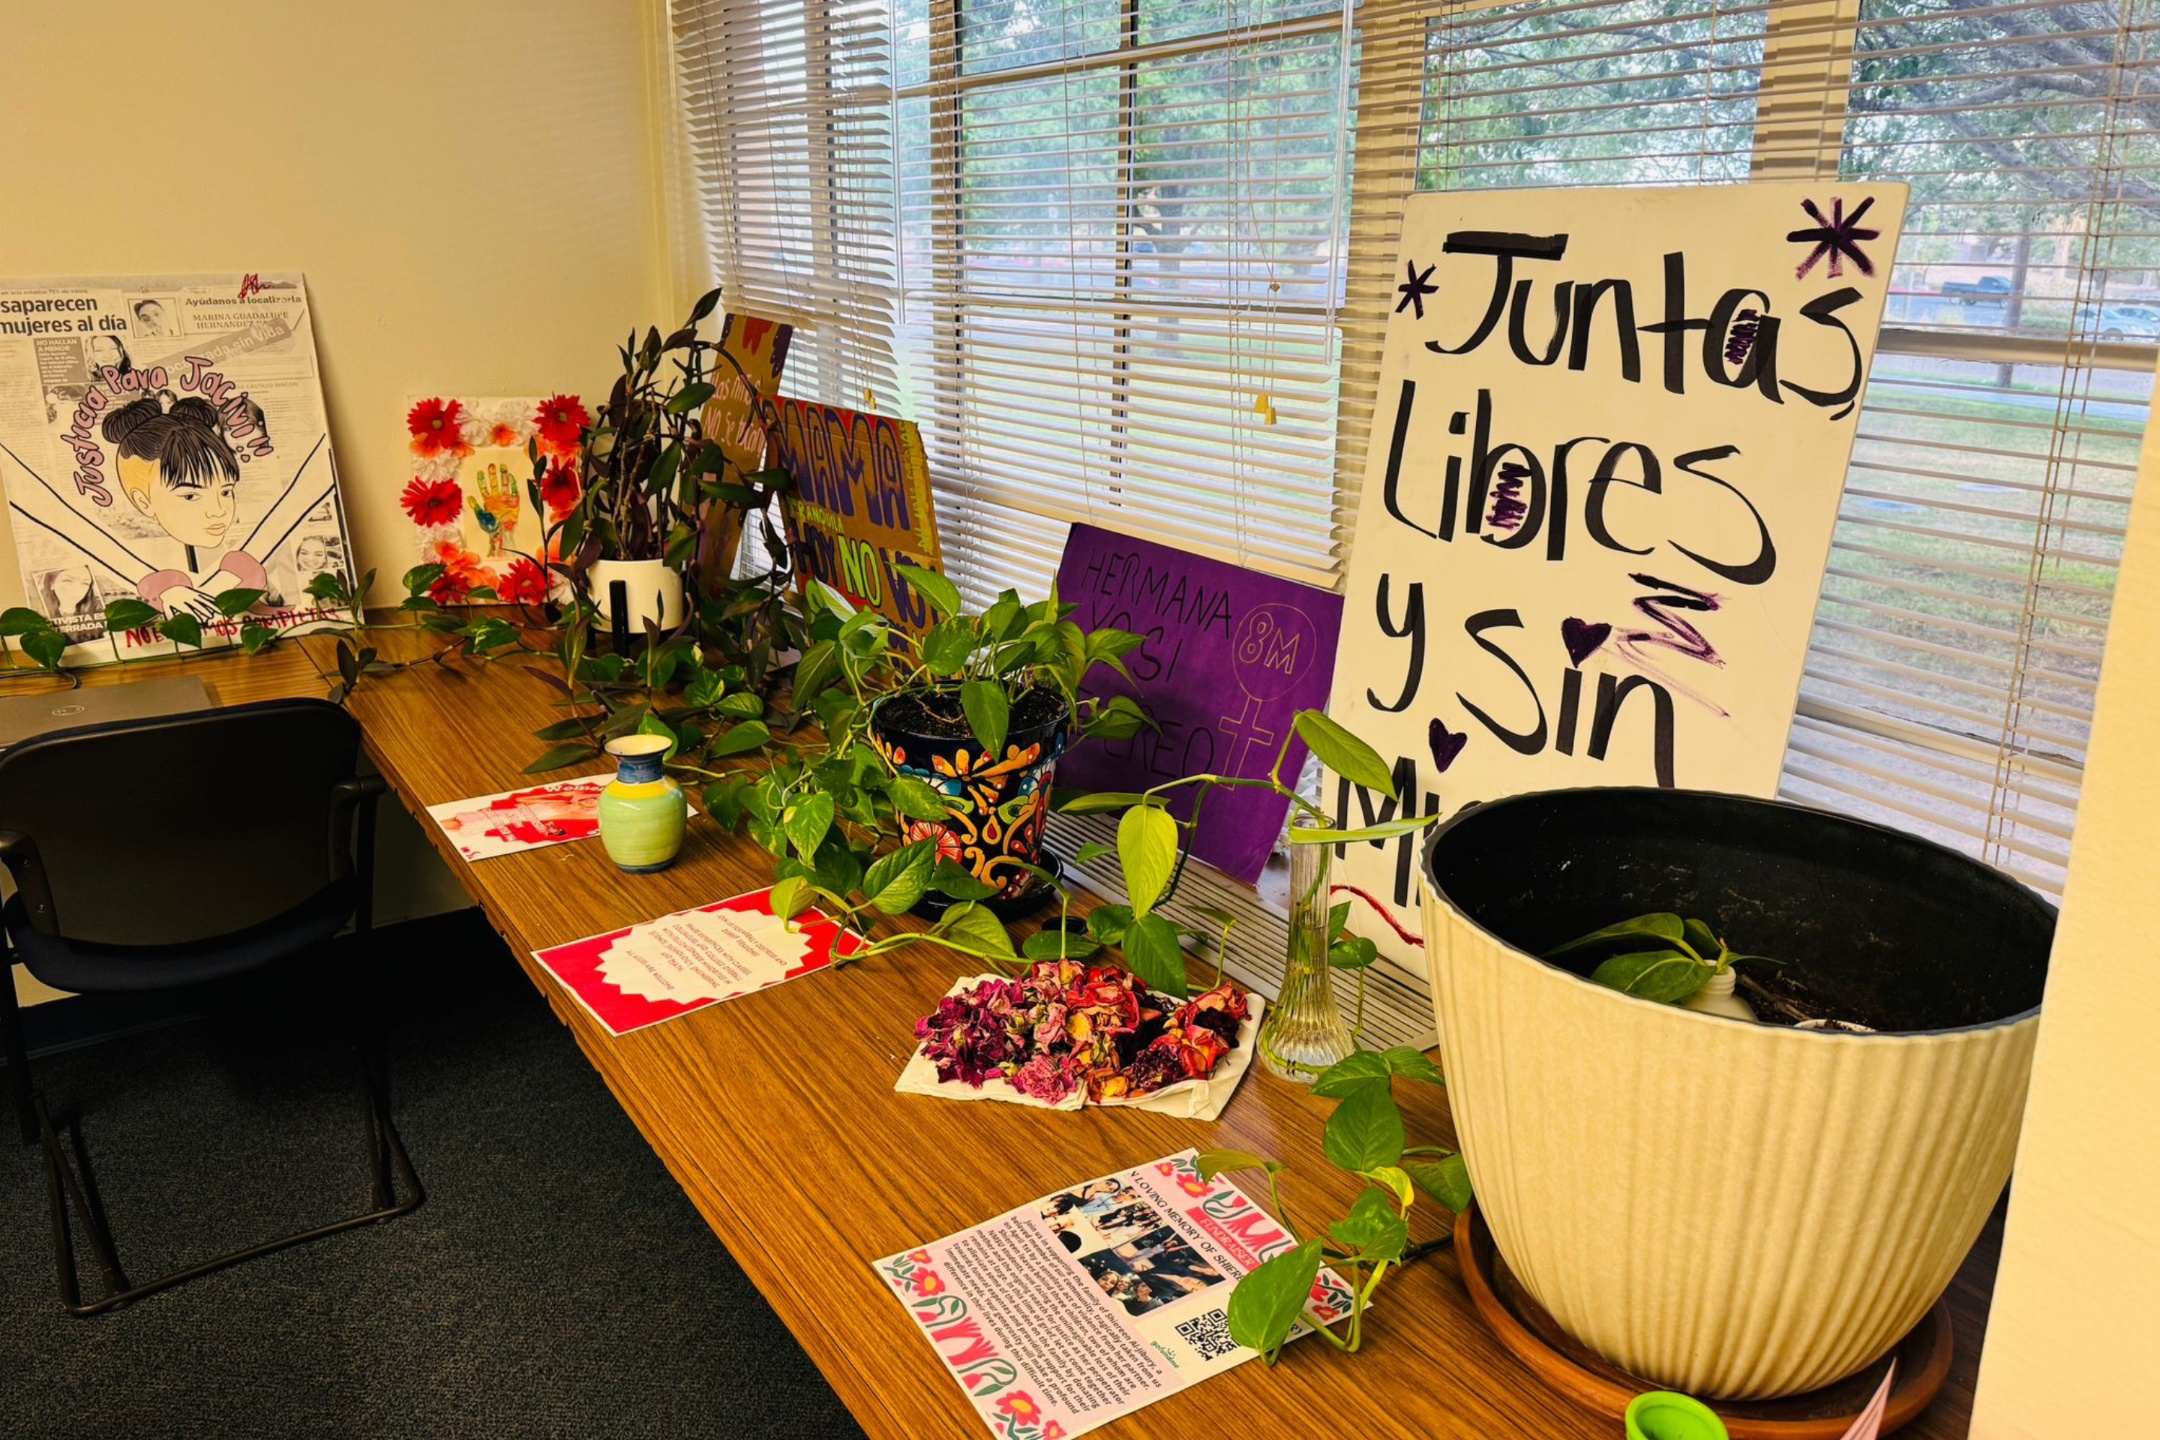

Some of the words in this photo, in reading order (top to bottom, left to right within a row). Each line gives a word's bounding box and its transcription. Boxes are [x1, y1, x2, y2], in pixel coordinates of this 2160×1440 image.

[0, 317, 73, 336] mujeres
[78, 315, 94, 332] al
[99, 314, 127, 331] día
[1, 298, 98, 316] saparecen
[193, 313, 231, 322] MARINA
[232, 336, 255, 351] sin
[247, 295, 301, 305] localizarla
[101, 364, 169, 394] Para
[1383, 379, 1777, 586] Libres
[837, 533, 882, 609] NO
[1081, 547, 1232, 641] HERMANA
[1132, 625, 1184, 683] SI
[1238, 611, 1301, 675] 8M
[1132, 1176, 1170, 1208] LOVING
[1163, 1207, 1204, 1241] MEMORY
[1198, 1240, 1217, 1254] OF
[1197, 1217, 1256, 1266] FUNDRAISER
[943, 1261, 968, 1291] difference
[970, 1297, 985, 1311] their
[982, 1310, 997, 1327] lives
[994, 1326, 1013, 1349] during
[1010, 1348, 1023, 1362] this
[1020, 1361, 1045, 1388] difficult
[944, 1247, 971, 1279] immediate
[984, 1297, 998, 1311] Your
[992, 1311, 1024, 1346] generosity
[1021, 1345, 1035, 1359] will
[1030, 1358, 1049, 1377] make
[1048, 1382, 1080, 1414] profound
[952, 1242, 973, 1267] towards
[970, 1266, 992, 1288] funeral
[987, 1287, 1012, 1315] expenses
[1008, 1314, 1023, 1327] and
[1016, 1326, 1046, 1359] providing
[1042, 1357, 1067, 1384] support
[1064, 1383, 1076, 1394] for
[1073, 1394, 1091, 1411] their
[966, 1247, 989, 1272] alleviate
[985, 1271, 1001, 1287] some
[1004, 1293, 1016, 1304] the
[1013, 1303, 1034, 1327] burden
[1038, 1335, 1050, 1347] the
[1047, 1347, 1068, 1369] family
[1072, 1377, 1100, 1409] donating
[969, 1235, 990, 1259] remains
[1011, 1287, 1024, 1300] this
[1021, 1298, 1036, 1314] time
[1053, 1338, 1065, 1350] let
[1068, 1357, 1086, 1376] come
[1084, 1375, 1112, 1405] together
[976, 1229, 995, 1250] mother
[991, 1250, 1005, 1262] and
[1001, 1261, 1012, 1272] the
[1009, 1271, 1031, 1294] ongoing
[1028, 1293, 1048, 1314] search
[1045, 1313, 1056, 1324] for
[1051, 1324, 1074, 1346] justice
[1078, 1353, 1092, 1366] her
[1086, 1366, 1125, 1404] perpetrator
[987, 1229, 1005, 1247] NMSU
[1022, 1273, 1036, 1285] now
[1033, 1284, 1052, 1305] facing
[1049, 1303, 1061, 1315] the
[1058, 1315, 1097, 1358] unimaginable
[1093, 1356, 1109, 1371] loss
[1112, 1378, 1130, 1396] their
[997, 1228, 1020, 1255] Shiereen
[1017, 1252, 1036, 1272] leaves
[1033, 1271, 1054, 1291] behind
[1050, 1290, 1067, 1308] three
[1087, 1335, 1101, 1349] two
[1105, 1356, 1126, 1377] whom
[1123, 1377, 1137, 1389] are
[1009, 1229, 1025, 1244] April
[1021, 1243, 1032, 1254] 1st
[1038, 1265, 1065, 1291] senseless
[1062, 1291, 1074, 1302] act
[1077, 1309, 1102, 1335] violence
[1099, 1334, 1116, 1352] from
[1113, 1350, 1127, 1362] her
[1010, 1215, 1033, 1239] beloved
[1028, 1238, 1051, 1262] member
[1054, 1268, 1066, 1277] our
[1093, 1314, 1122, 1343] tragically
[1119, 1343, 1139, 1363] taken
[1136, 1361, 1154, 1379] from
[1022, 1219, 1037, 1232] Join
[1045, 1246, 1075, 1276] supporting
[1072, 1275, 1084, 1287] the
[1081, 1286, 1101, 1306] family
[1104, 1312, 1131, 1341] Shiereen
